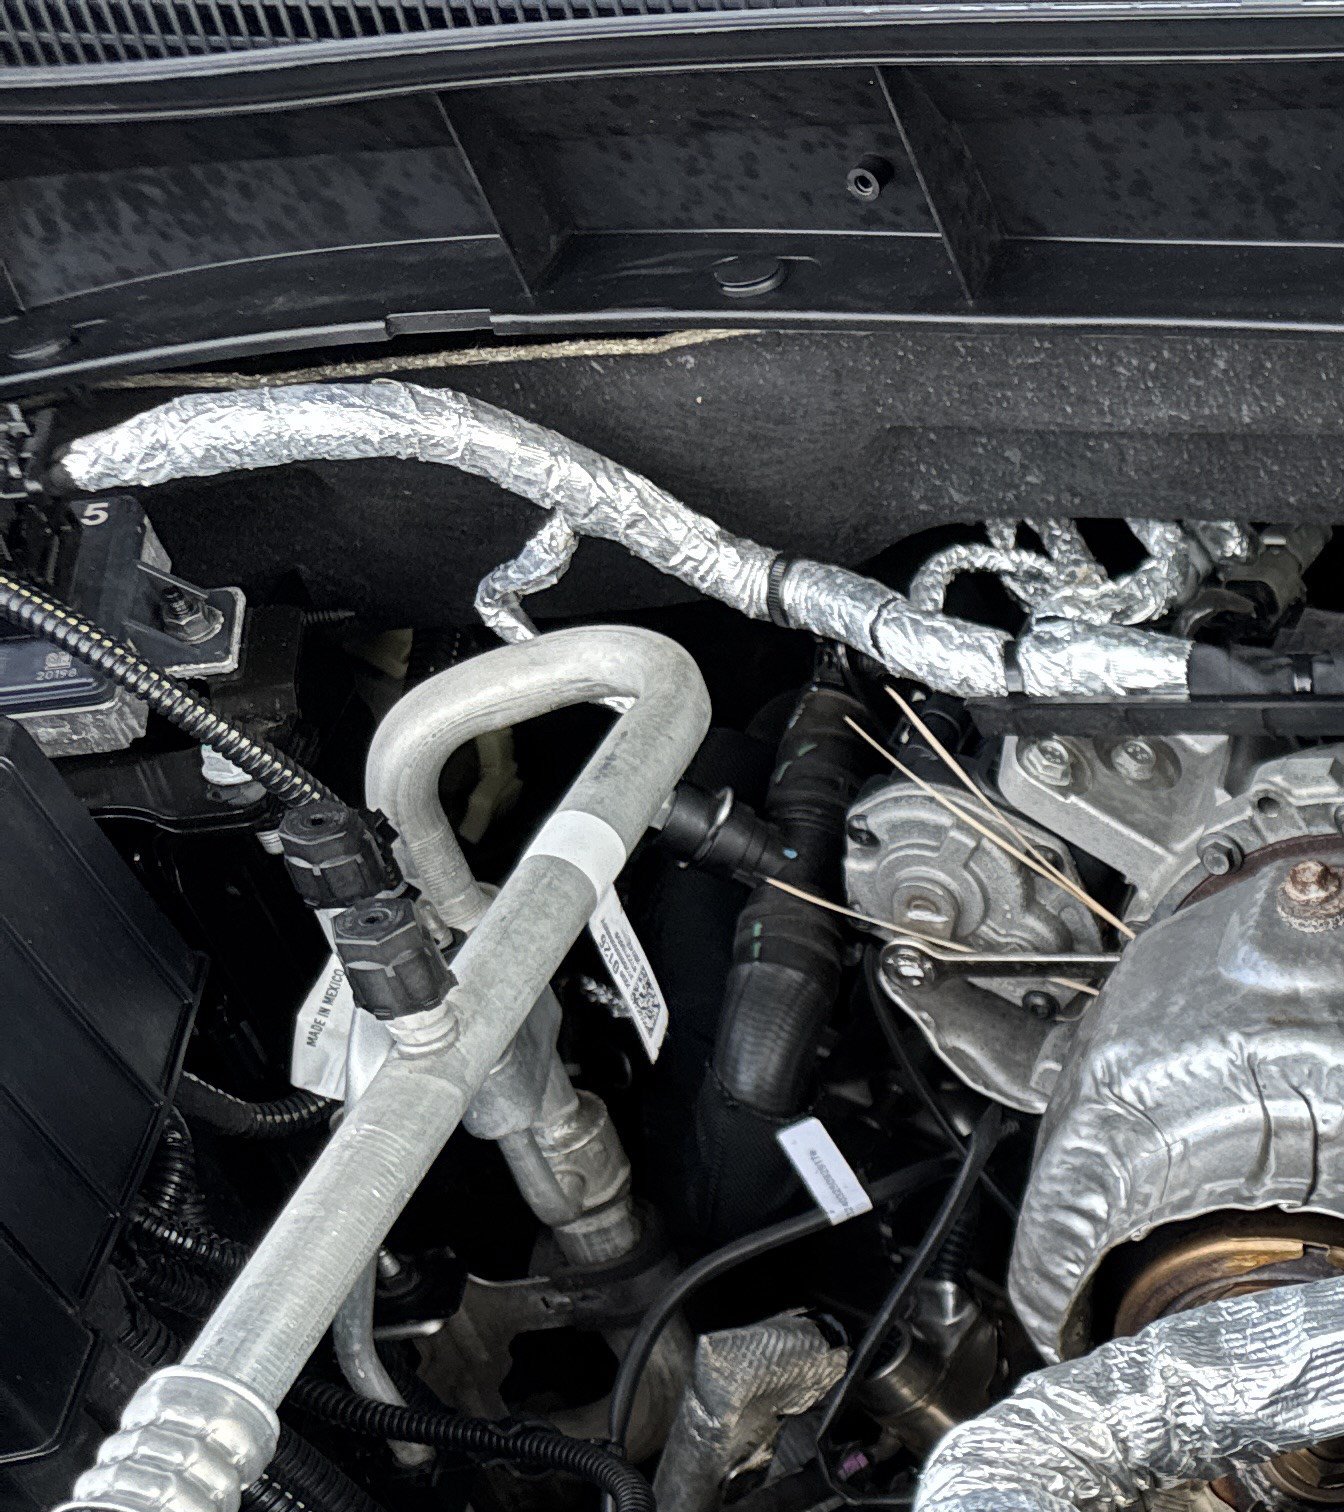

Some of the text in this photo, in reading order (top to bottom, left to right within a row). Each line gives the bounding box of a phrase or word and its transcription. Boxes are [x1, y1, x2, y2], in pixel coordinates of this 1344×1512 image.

[80, 502, 109, 526] 5
[306, 968, 346, 1047] MADE IN MEXICO
